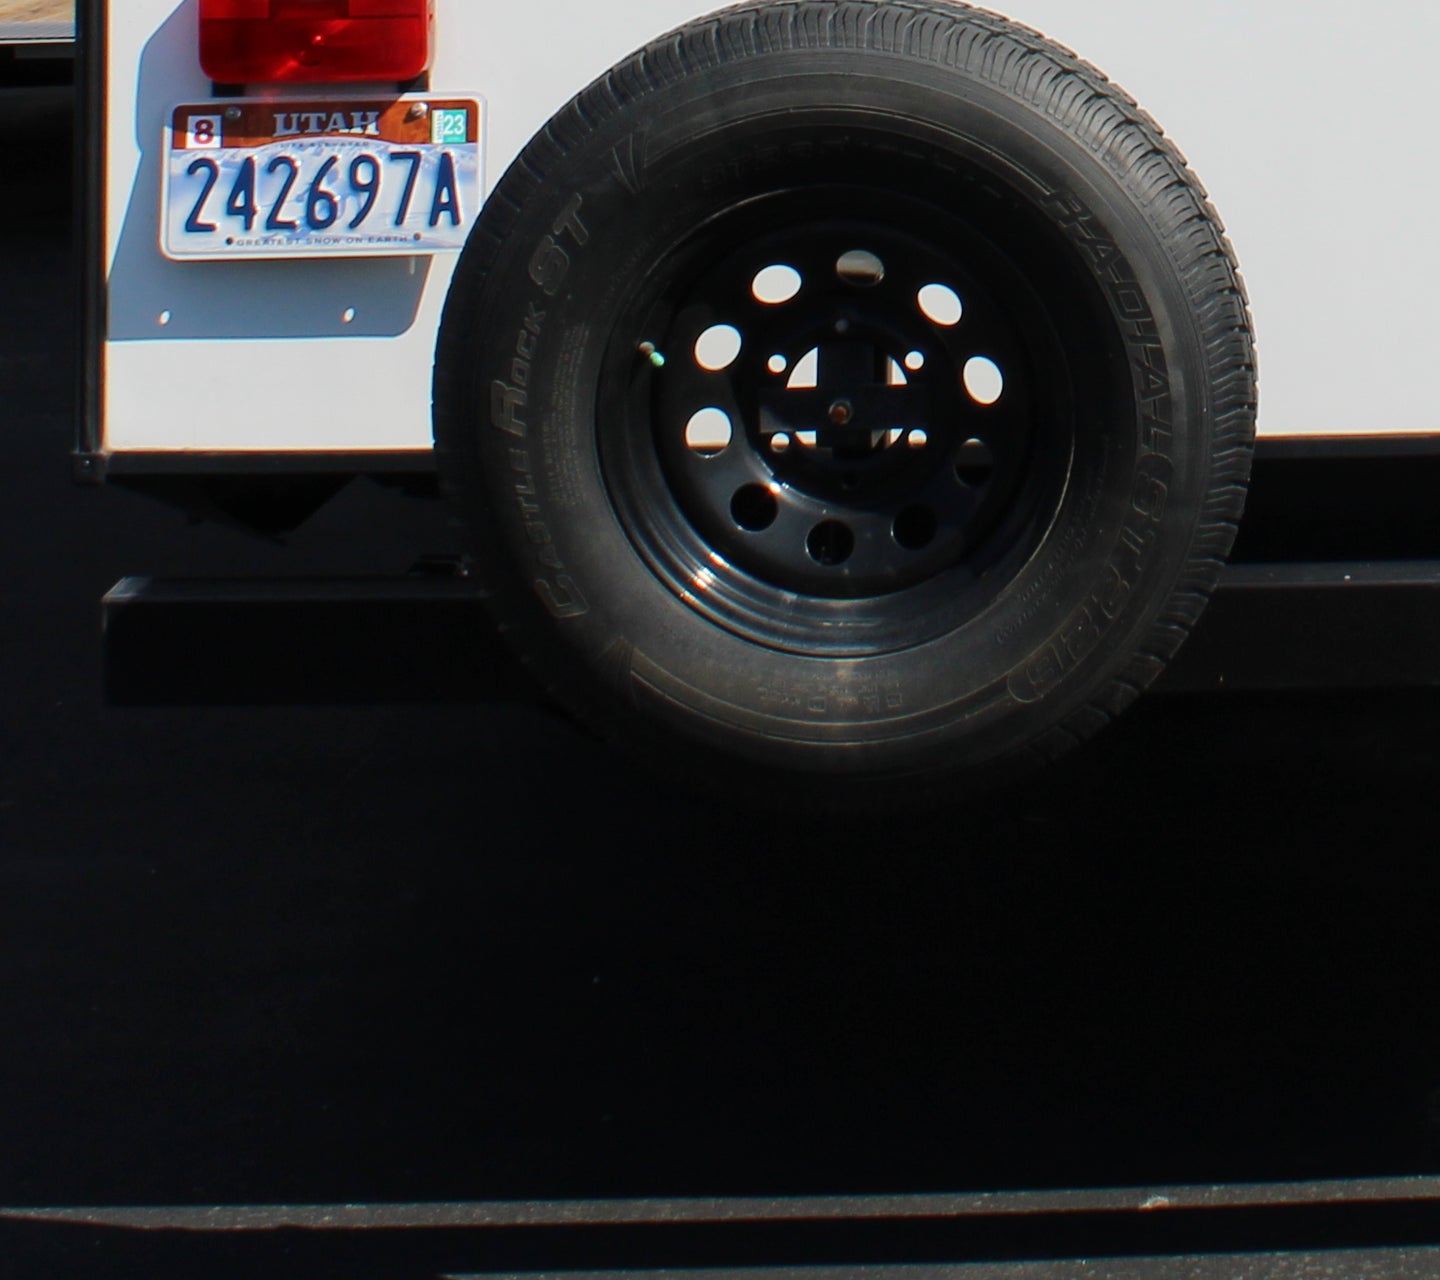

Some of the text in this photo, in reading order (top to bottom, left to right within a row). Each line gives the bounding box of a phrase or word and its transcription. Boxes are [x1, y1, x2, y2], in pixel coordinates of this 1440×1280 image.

[194, 119, 216, 146] 8
[273, 111, 380, 137] UTAH
[443, 114, 464, 135] 23
[185, 150, 463, 234] 242697A
[236, 234, 408, 245] GREATEST SNOW ON EARTH
